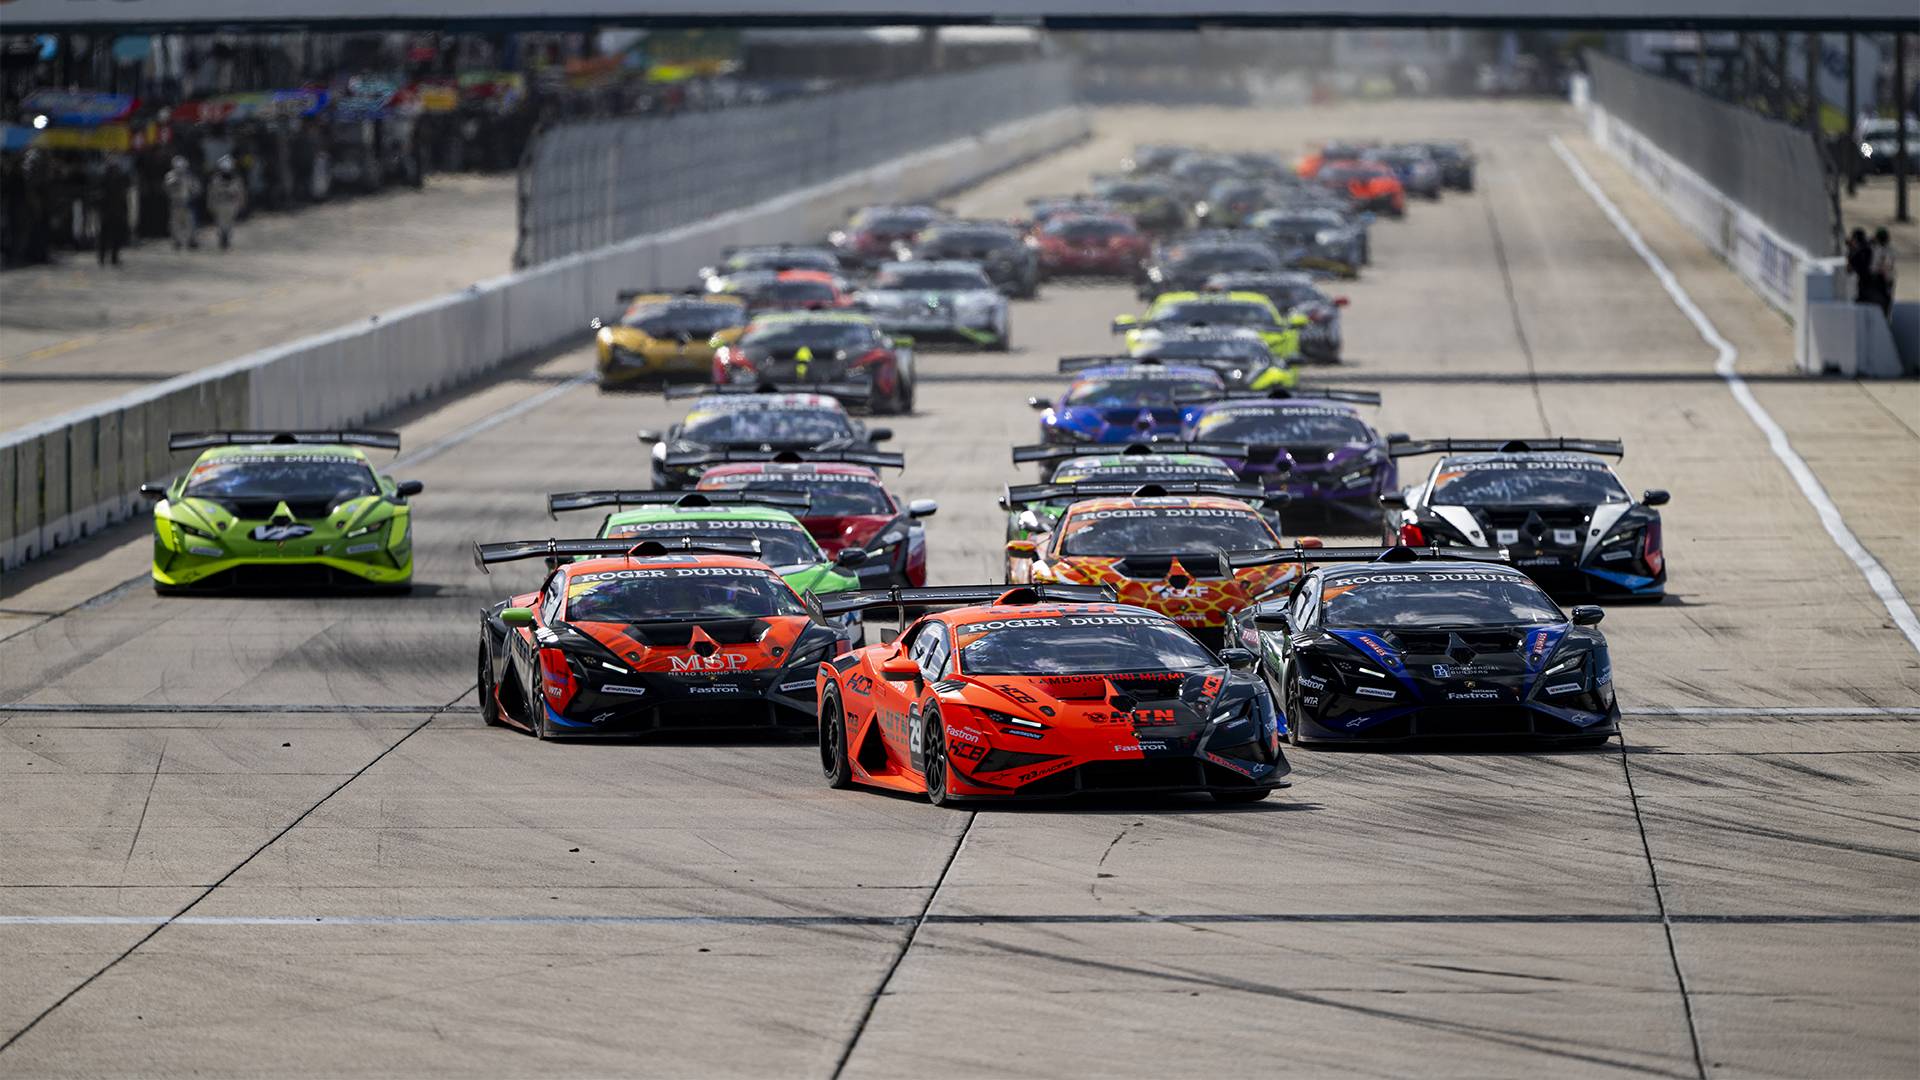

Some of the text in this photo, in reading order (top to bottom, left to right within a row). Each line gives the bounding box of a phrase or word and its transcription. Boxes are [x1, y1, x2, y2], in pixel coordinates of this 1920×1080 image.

[1068, 466, 1222, 476] ROGER DUBUIS
[1449, 462, 1602, 472] ROGER DUBUIS
[712, 474, 869, 484] ROGER DUBUIS
[1082, 509, 1248, 520] ROGER DUBUIS
[621, 521, 793, 532] ROGER DUBUIS
[582, 568, 769, 582] ROGER DUBUIS
[1335, 573, 1522, 586] ROGER DUBUIS
[968, 616, 1166, 633] ROGER DUBUIS
[667, 653, 748, 671] MSP
[1139, 672, 1185, 681] MIAMI
[946, 725, 979, 743] Fastron
[949, 739, 985, 761] HCB
[1114, 744, 1167, 752] Fastron
